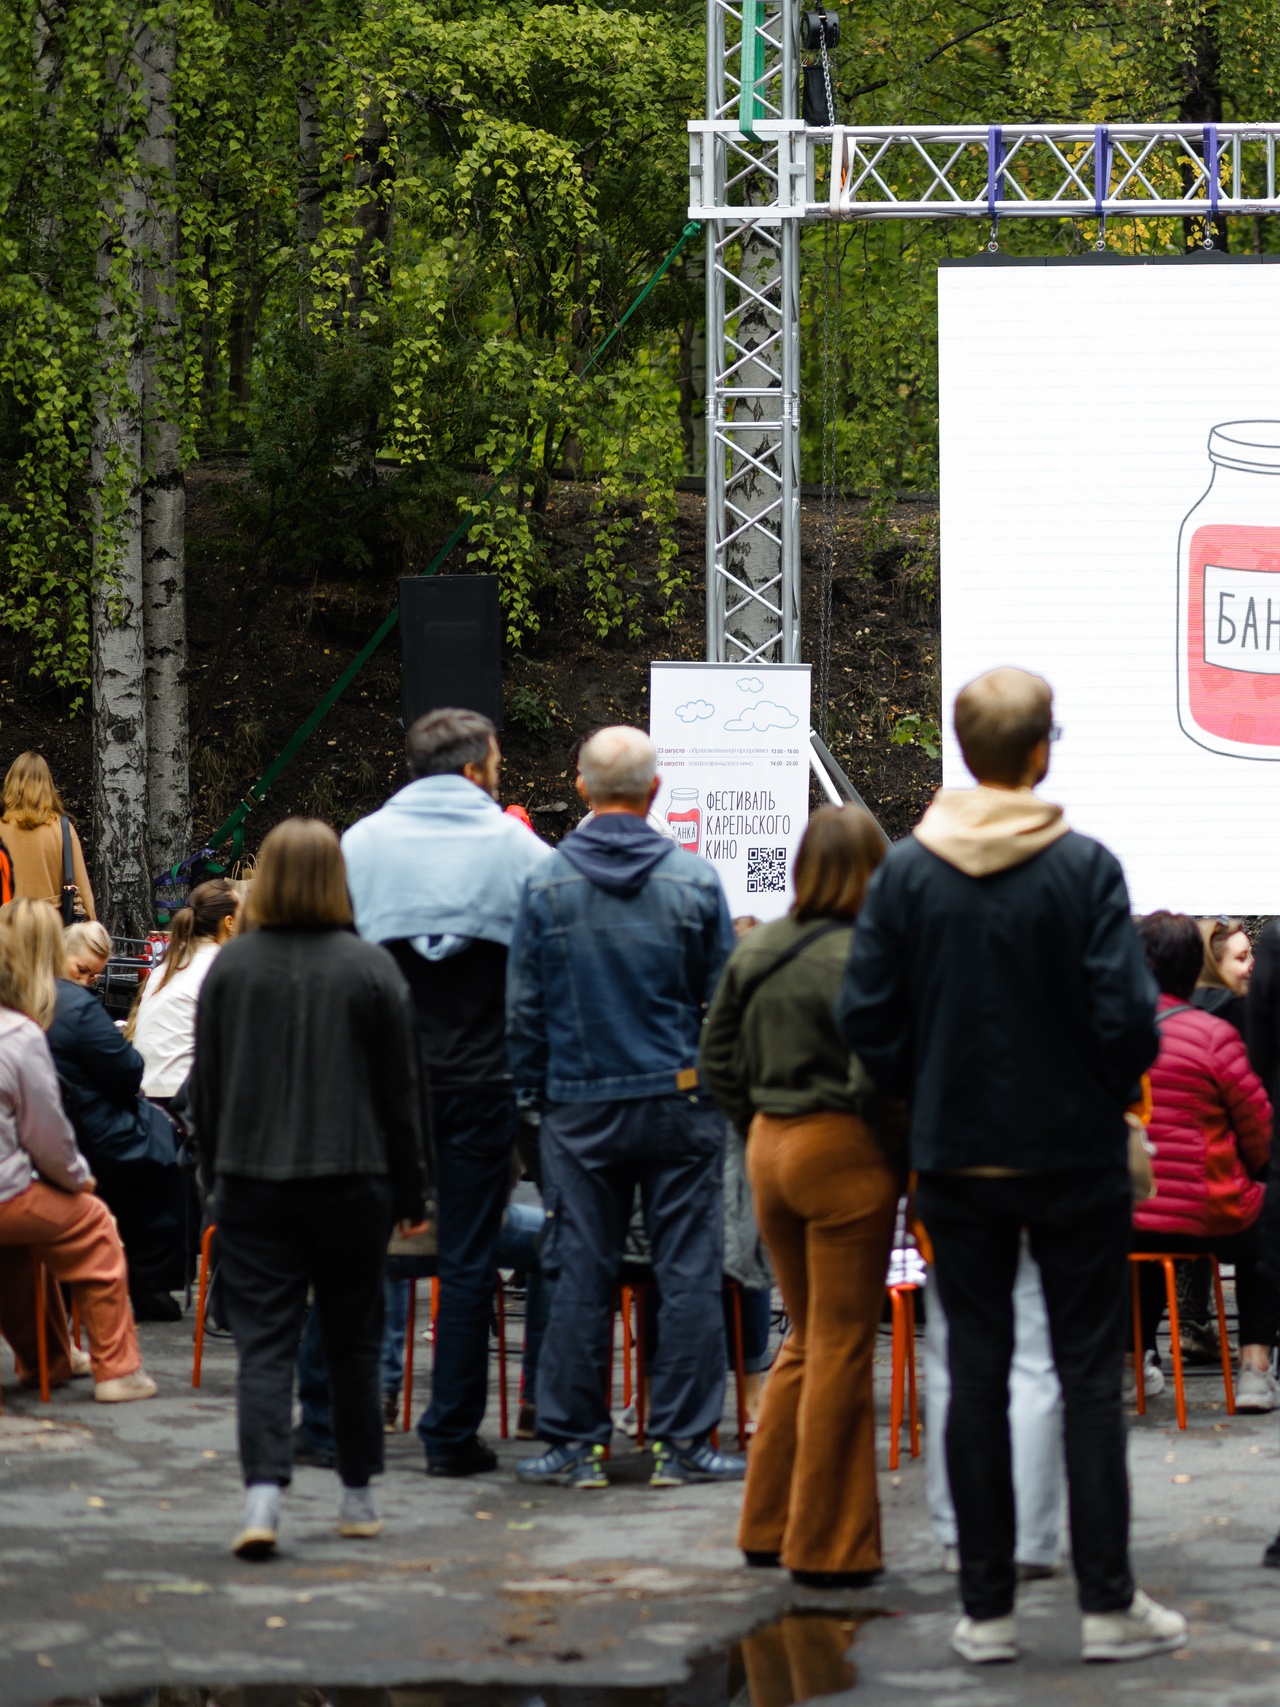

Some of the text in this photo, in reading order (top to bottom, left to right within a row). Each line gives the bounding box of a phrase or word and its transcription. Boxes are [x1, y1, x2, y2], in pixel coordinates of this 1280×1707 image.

[706, 790, 776, 811] ФЕСТИВАЛЬ
[706, 814, 791, 836] КАРЕЛЬСКОГО
[705, 839, 738, 860] КИНО
